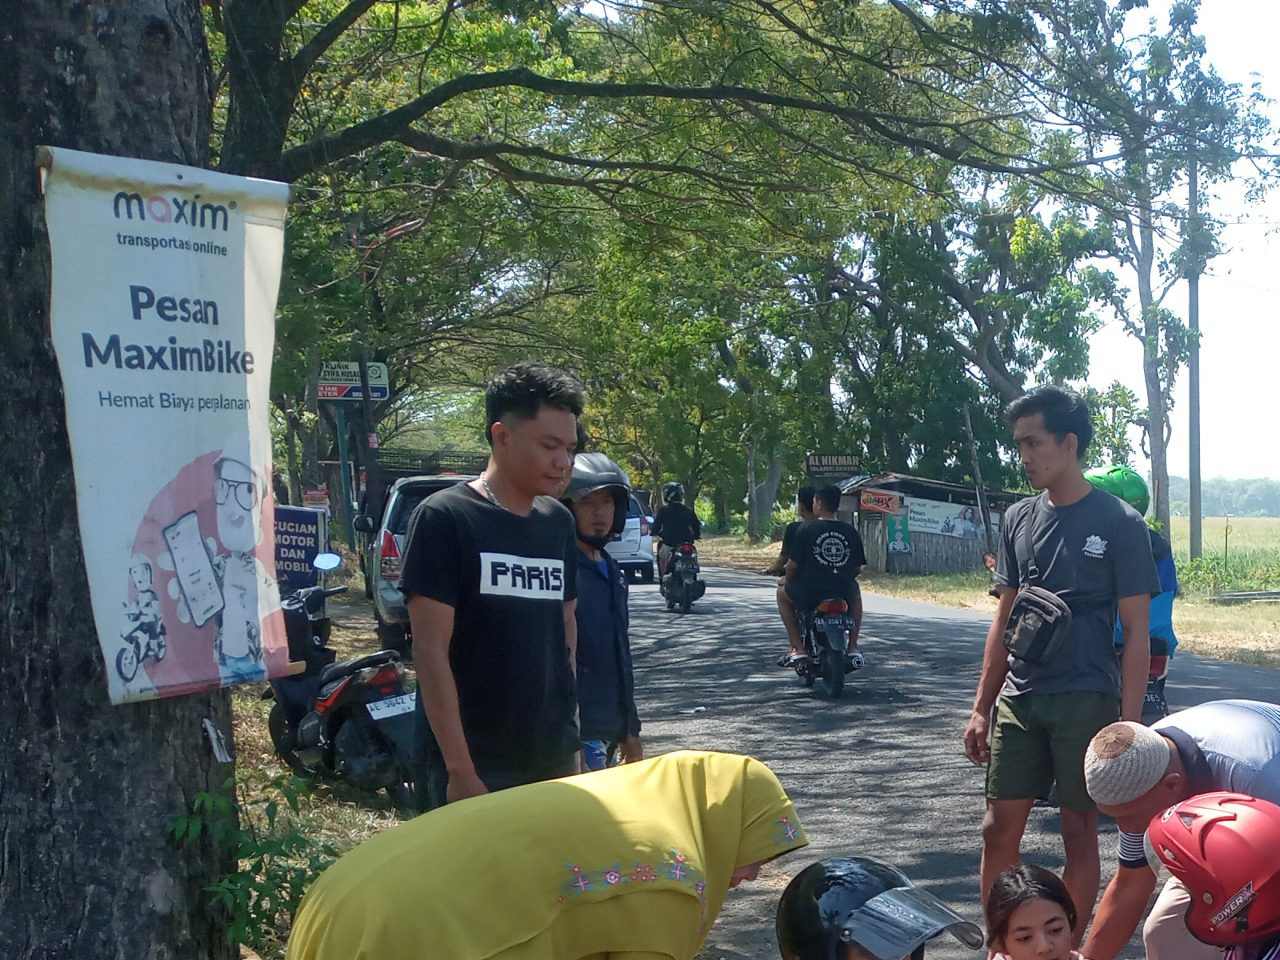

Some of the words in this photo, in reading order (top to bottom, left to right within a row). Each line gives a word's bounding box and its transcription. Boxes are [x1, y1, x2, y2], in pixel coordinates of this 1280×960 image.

[113, 192, 229, 232] maxim
[193, 241, 228, 256] online
[129, 285, 219, 326] Pesan
[81, 332, 255, 374] MaximBike
[98, 391, 155, 409] Hemat
[821, 455, 859, 466] HIKMAH
[280, 548, 306, 559] DAN
[276, 560, 314, 573] MOBIL
[490, 561, 563, 592] PARIS
